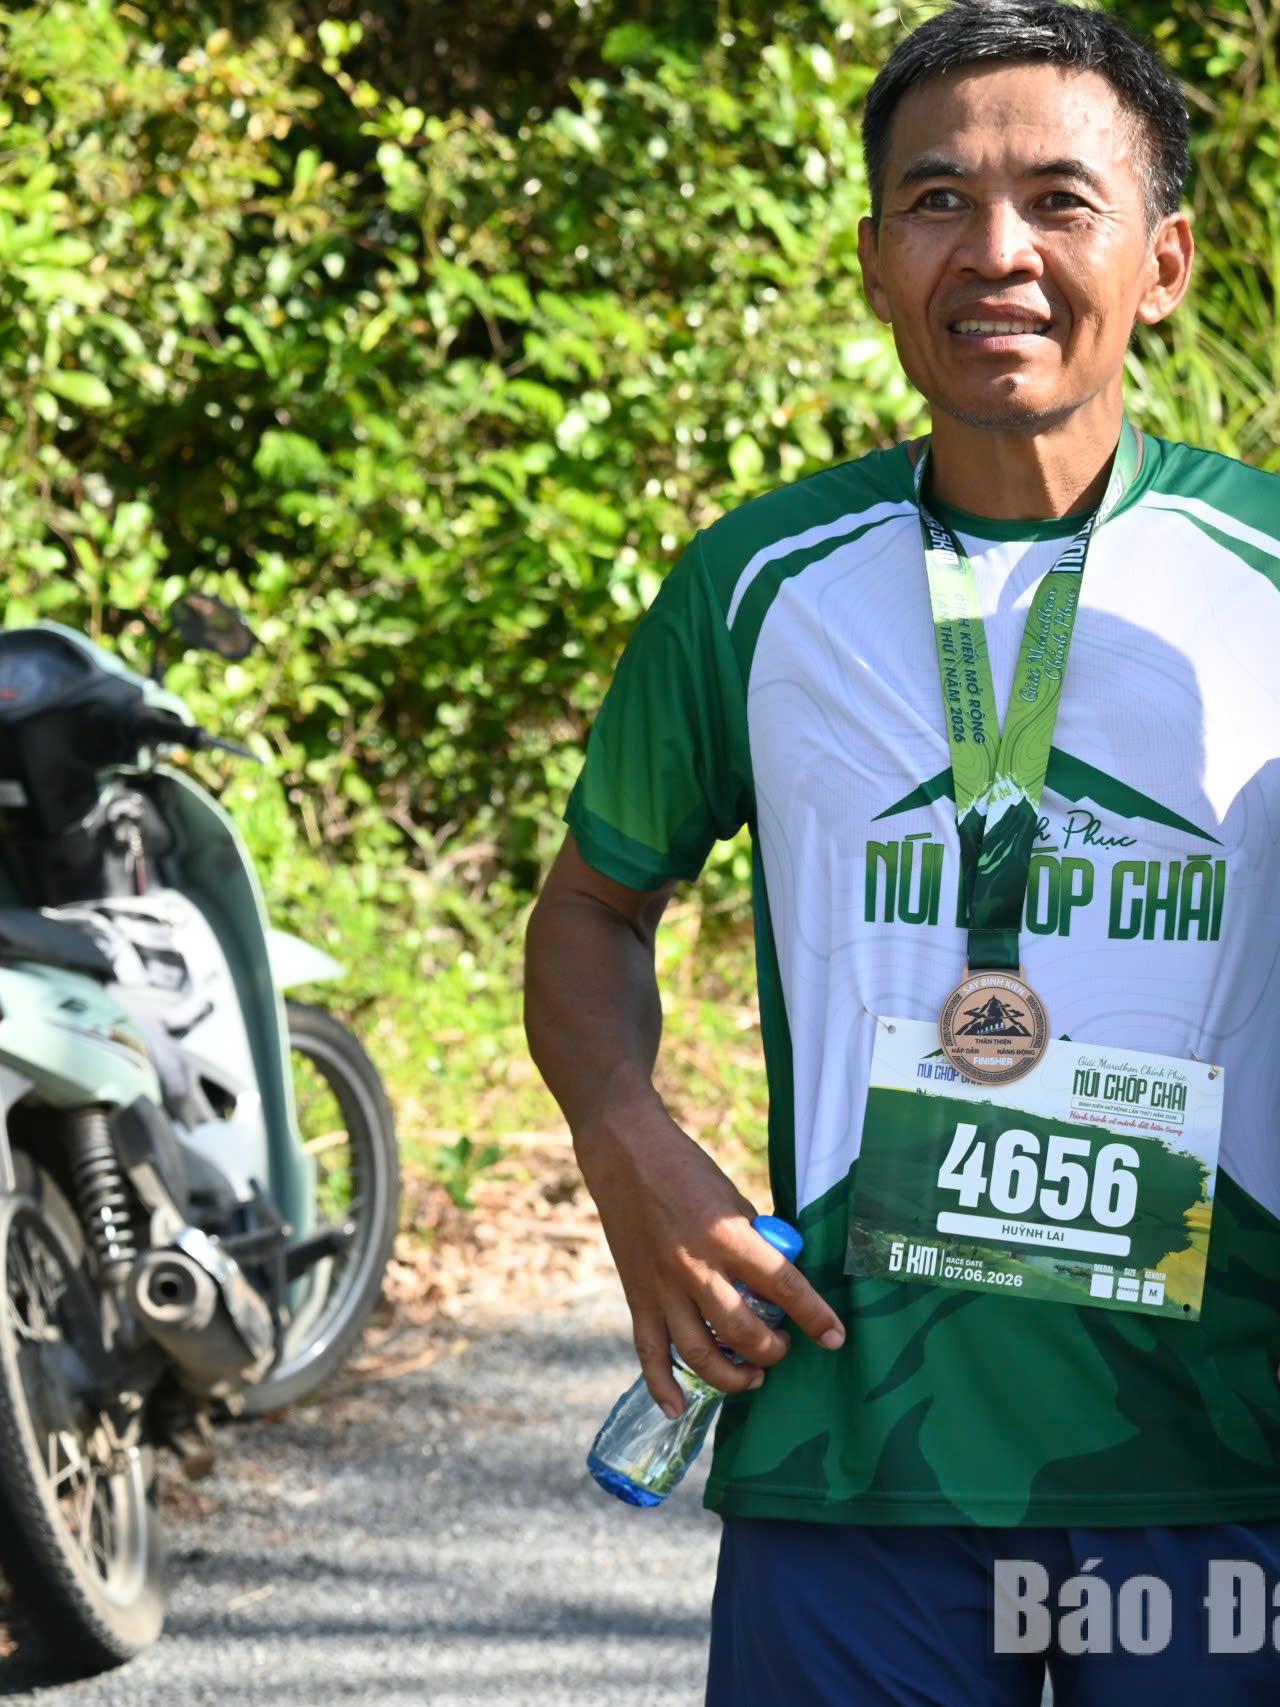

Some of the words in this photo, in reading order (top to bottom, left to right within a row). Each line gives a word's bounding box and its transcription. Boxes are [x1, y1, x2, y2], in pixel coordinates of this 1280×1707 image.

[1027, 588, 1058, 666] Marathon
[960, 631, 980, 665] KIẾN
[945, 666, 962, 702] NĂM
[964, 669, 984, 695] MỞ
[950, 706, 966, 744] 2026
[967, 699, 986, 745] RỘNG
[1063, 809, 1137, 851] Phục
[863, 832, 945, 925] NÚI
[1108, 854, 1227, 942] CHÀI
[963, 981, 979, 995] SAY
[973, 1056, 1013, 1067] FINISHER
[1097, 1057, 1138, 1074] Marathon
[1072, 1068, 1101, 1098] NÚI
[1103, 1074, 1148, 1104] CHÓP
[1150, 1082, 1188, 1112] CHÀI
[937, 1122, 1140, 1228] 4656
[1002, 1224, 1043, 1239] HUỲNH
[1047, 1230, 1065, 1242] LAI
[889, 1242, 905, 1272] 5
[906, 1244, 938, 1276] KM
[944, 1265, 1023, 1287] 07.06.2026
[946, 1256, 965, 1266] RACE
[965, 1259, 983, 1268] DATE
[1093, 1263, 1114, 1274] MEDAL
[1124, 1267, 1137, 1277] SIZE
[1149, 1289, 1158, 1297] M
